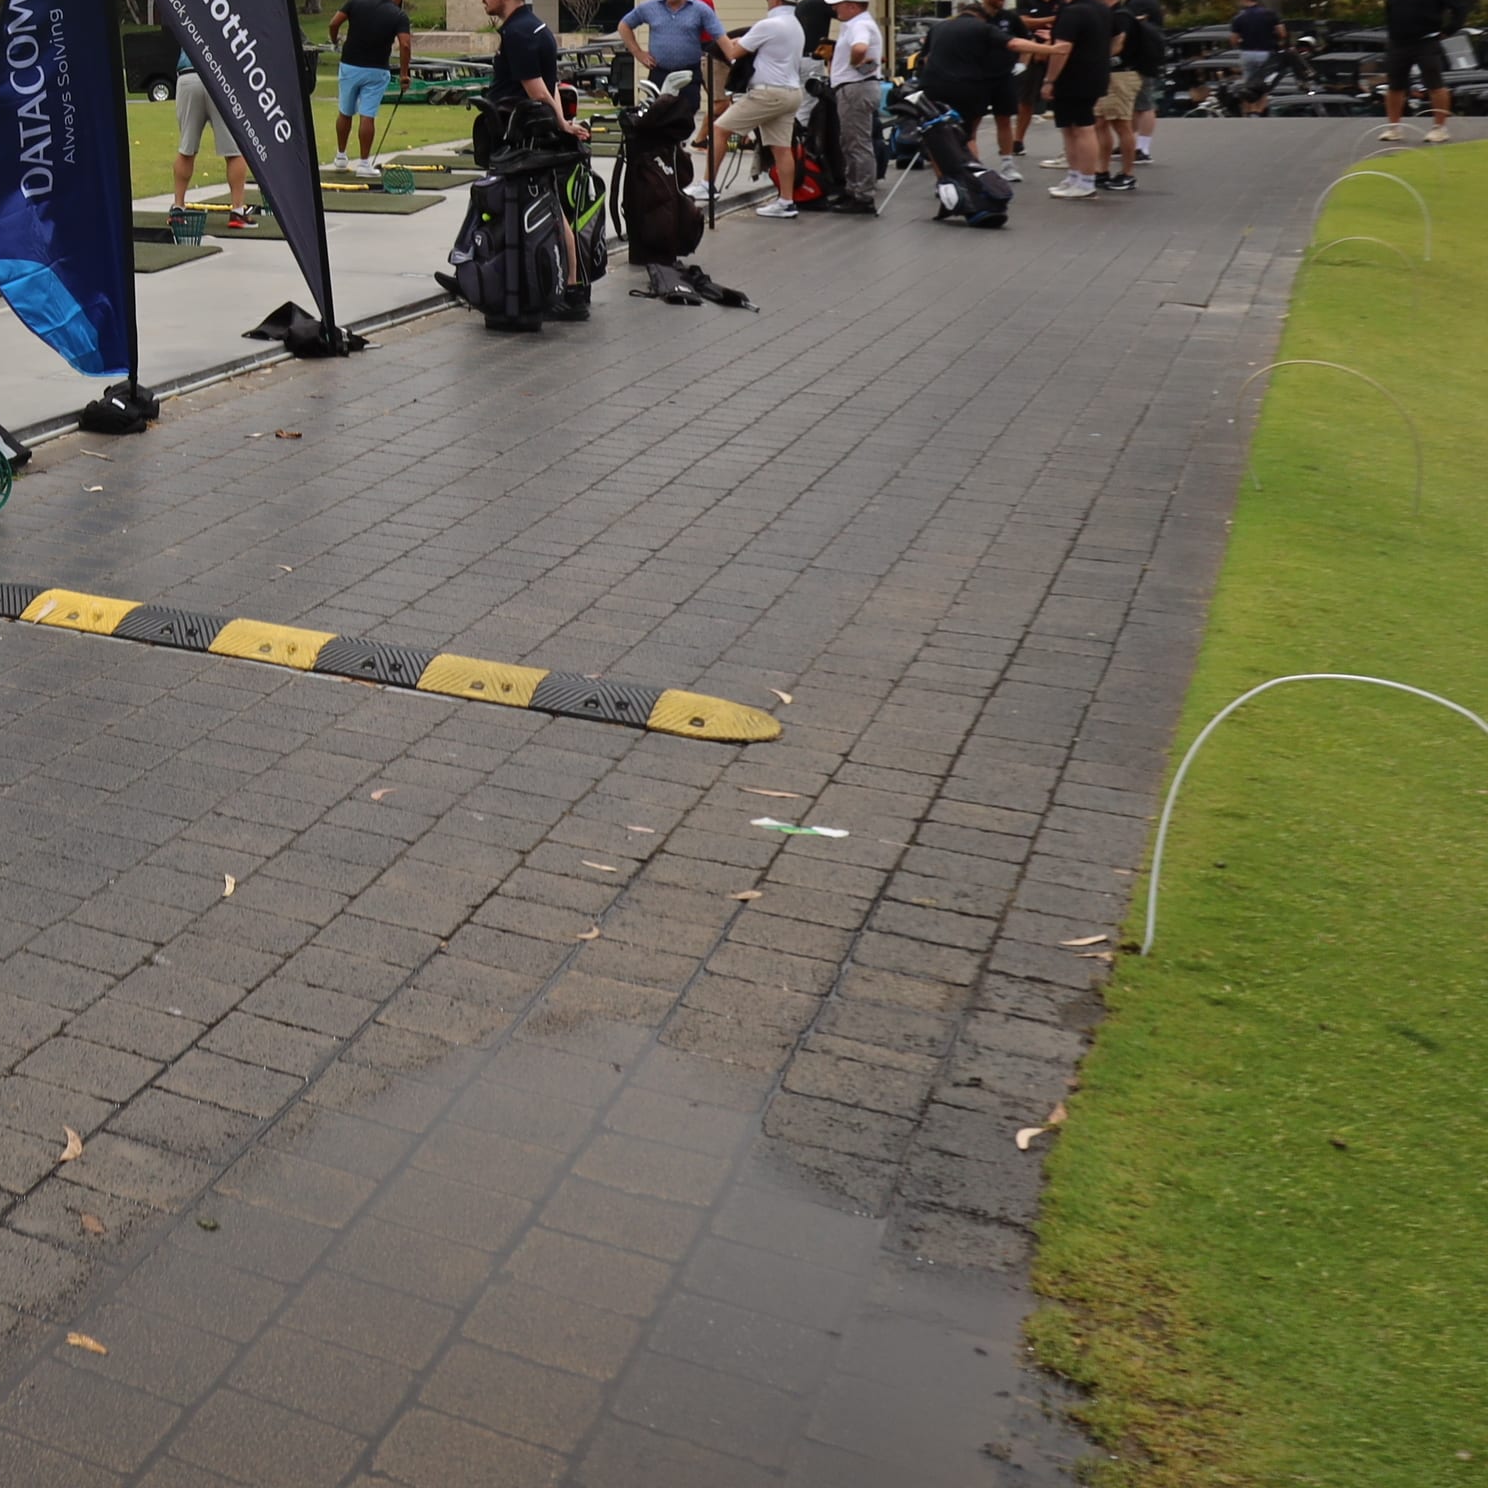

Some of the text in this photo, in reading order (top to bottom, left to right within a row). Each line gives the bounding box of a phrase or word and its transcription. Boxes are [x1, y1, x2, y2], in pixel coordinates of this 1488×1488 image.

[49, 8, 76, 164] Always Solving
[181, 16, 205, 46] your
[201, 42, 245, 121] technology
[242, 119, 268, 163] needs
